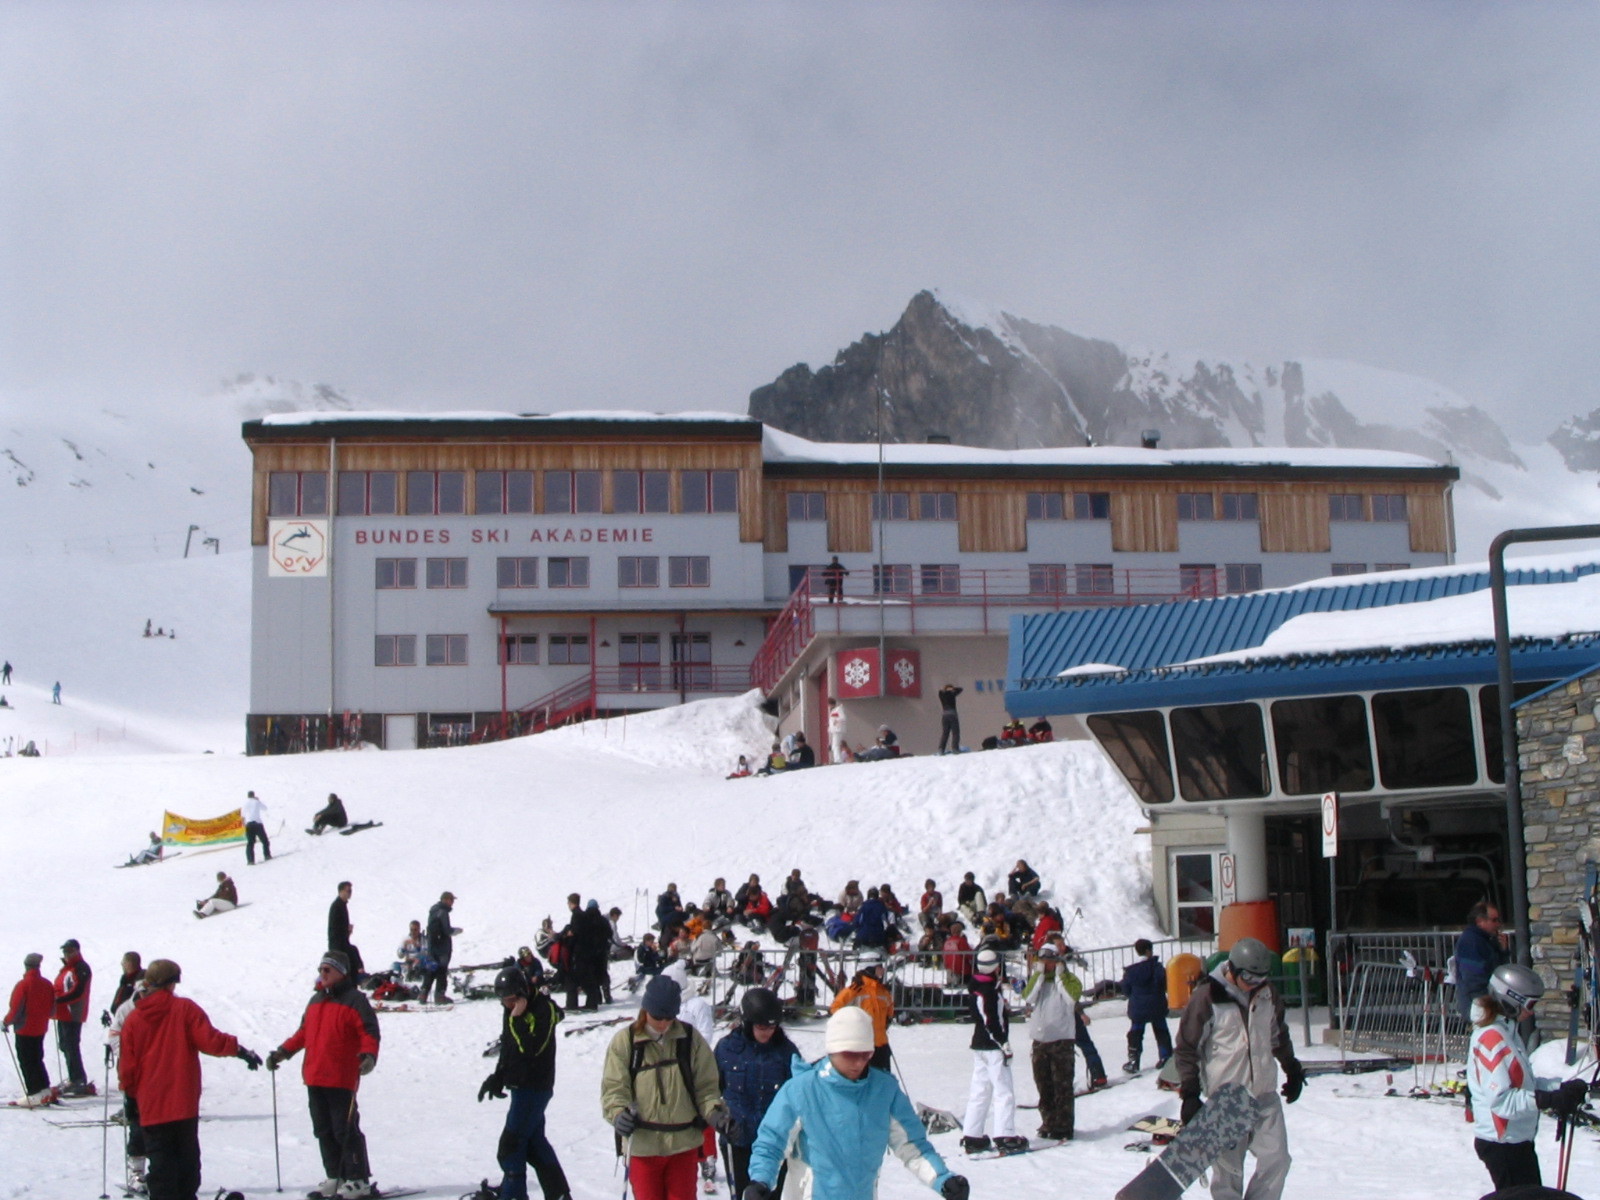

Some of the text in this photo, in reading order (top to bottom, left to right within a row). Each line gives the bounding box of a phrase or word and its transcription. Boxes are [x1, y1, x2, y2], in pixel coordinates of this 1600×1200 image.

[355, 528, 653, 544] BUNDES SKI AKADEMIE
